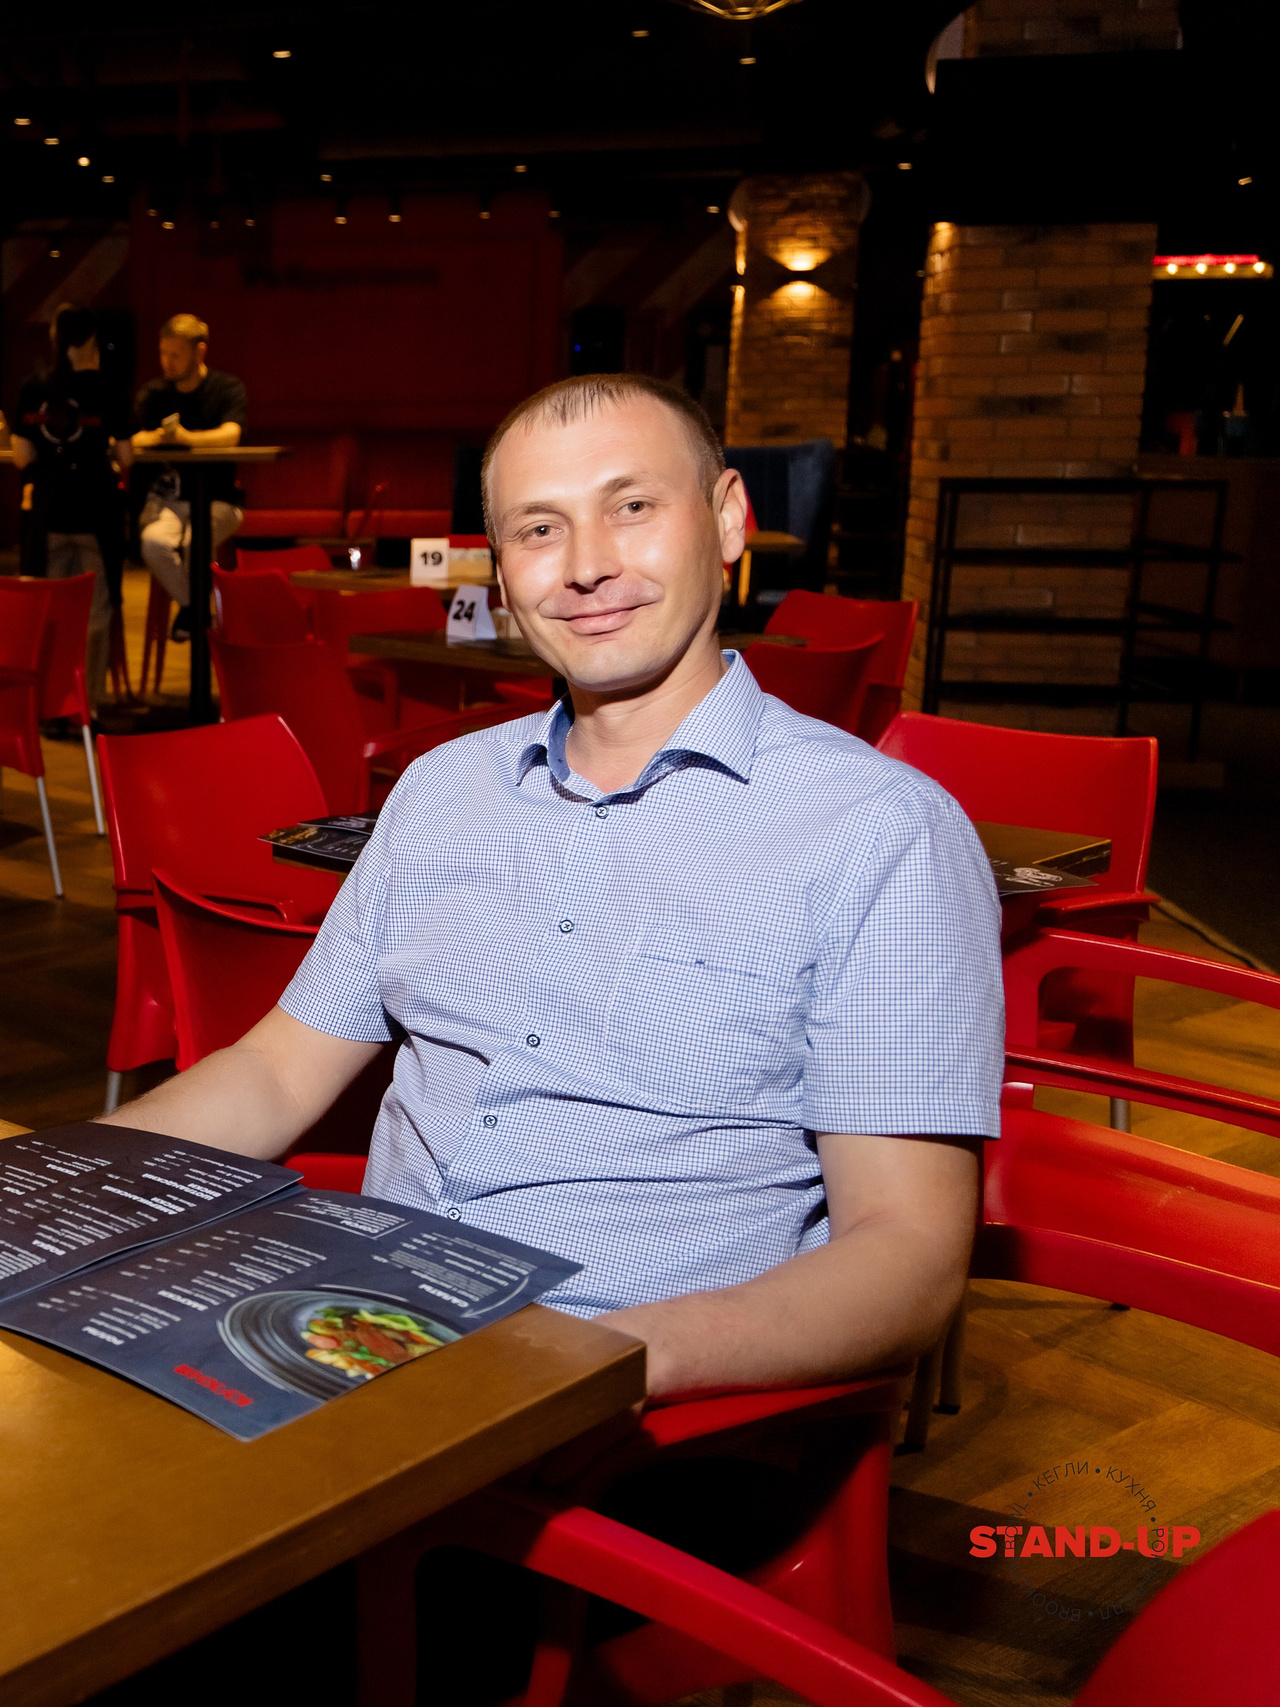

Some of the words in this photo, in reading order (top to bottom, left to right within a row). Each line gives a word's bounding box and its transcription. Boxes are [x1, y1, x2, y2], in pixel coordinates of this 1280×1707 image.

[420, 551, 443, 566] 19
[452, 600, 477, 622] 24
[44, 1163, 81, 1176] ТЕКИЛА
[0, 1186, 27, 1195] РОМ
[138, 1172, 215, 1200] ШОТЛАНДСКИЙ
[185, 1182, 223, 1197] ВИСКИ
[98, 1184, 179, 1215] АМЕРИКАНСКИЙ
[148, 1196, 186, 1212] ВИСКИ
[30, 1239, 67, 1255] ВОДКА
[416, 1283, 472, 1308] САЛАТЫ
